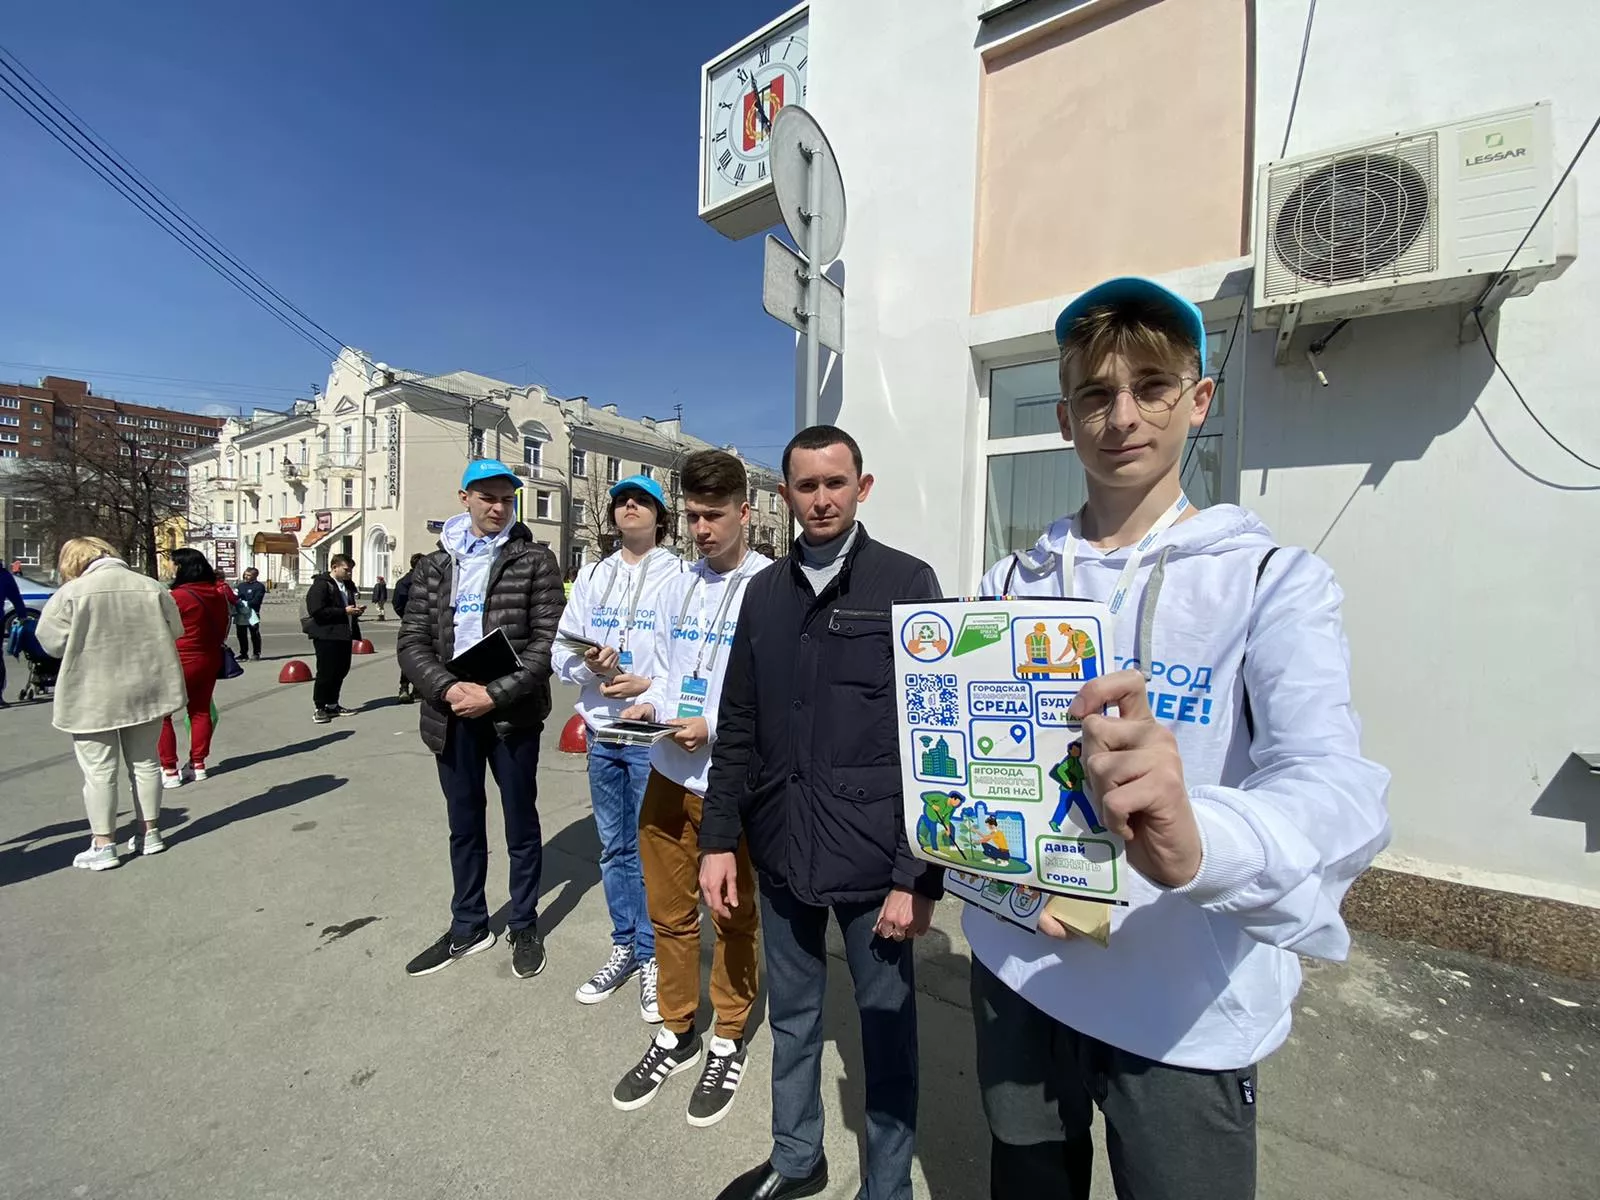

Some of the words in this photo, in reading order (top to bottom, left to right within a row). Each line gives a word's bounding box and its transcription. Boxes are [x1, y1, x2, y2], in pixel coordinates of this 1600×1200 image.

[1465, 148, 1526, 167] LESSAR
[973, 685, 1026, 693] ГОРОДСКАЯ
[973, 700, 1029, 714] СРЕДА
[1040, 698, 1073, 708] БУДУ
[1041, 712, 1057, 721] ЗА
[1060, 712, 1081, 721] НА
[974, 767, 1024, 777] #ГОРОДА
[988, 786, 1011, 795] ДЛЯ
[1013, 788, 1036, 796] НАС
[1044, 843, 1086, 855] давай
[1045, 856, 1102, 872] МЕНЯТЬ
[1046, 872, 1088, 887] город
